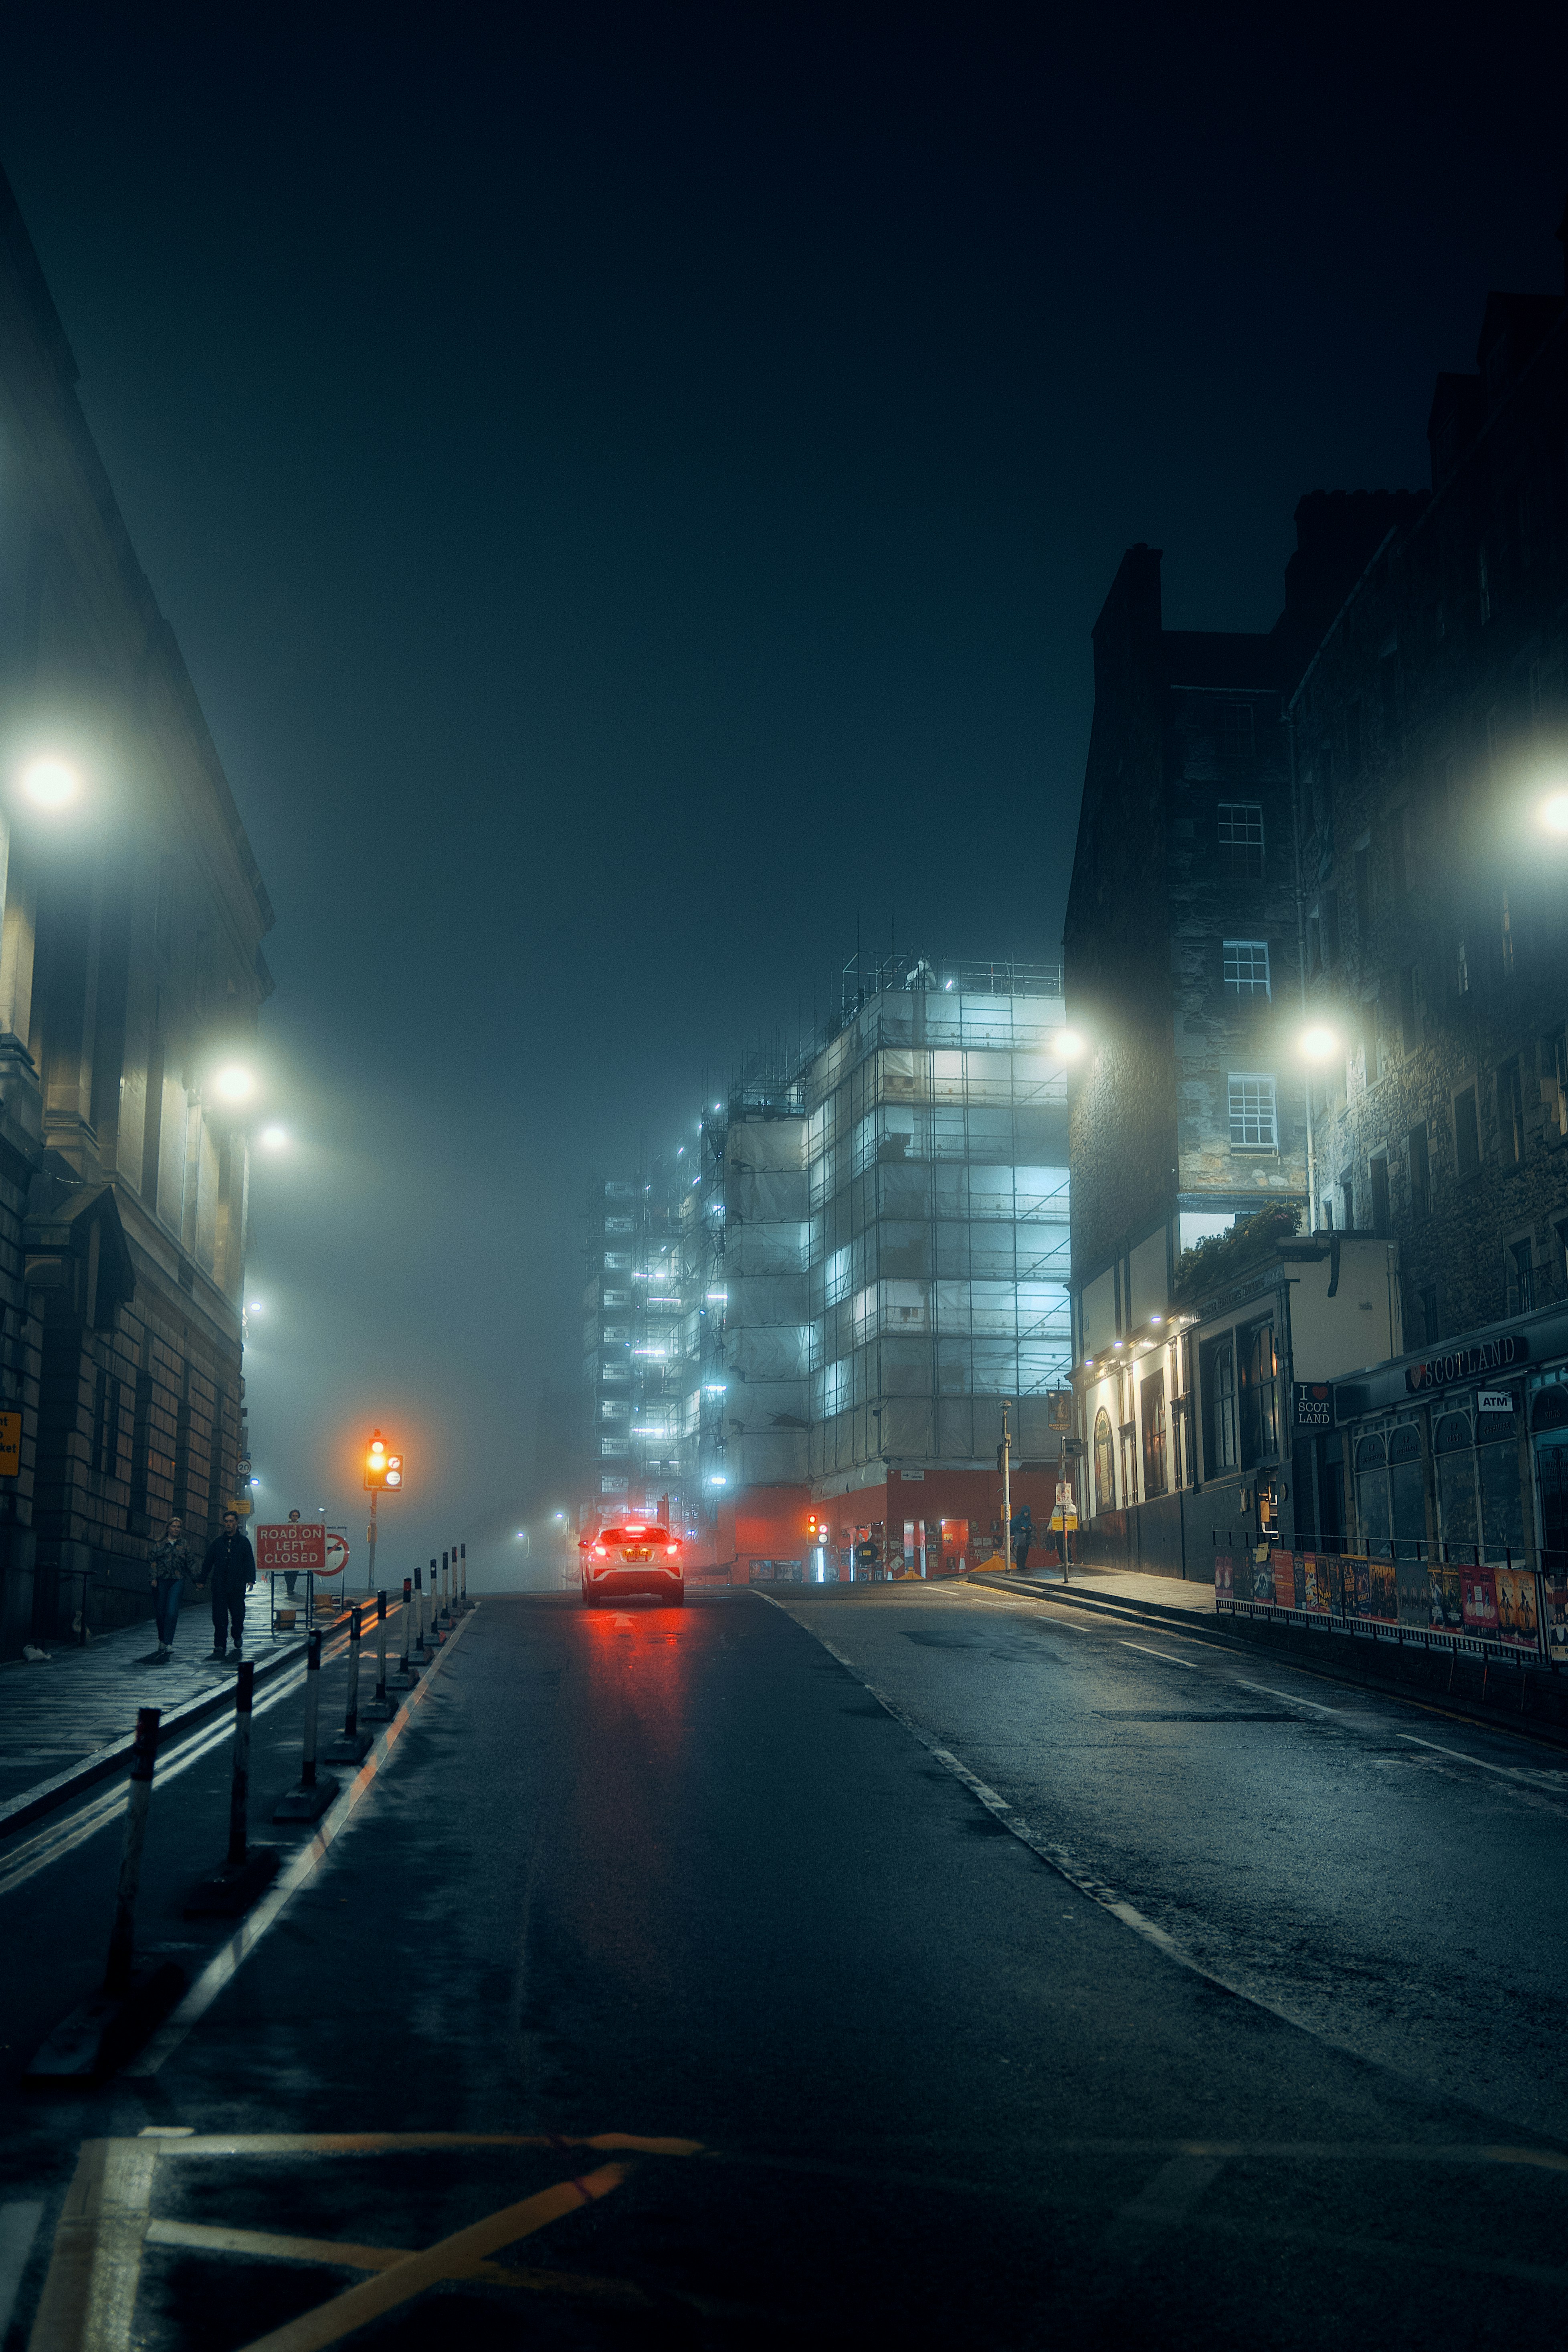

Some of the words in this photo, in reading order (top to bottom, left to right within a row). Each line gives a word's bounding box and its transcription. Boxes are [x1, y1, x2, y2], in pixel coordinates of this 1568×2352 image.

[1425, 1336, 1514, 1387] SCOTLAND
[1300, 1385, 1307, 1400] I
[1483, 1397, 1507, 1406] ATM
[1298, 1402, 1329, 1412] SCOT
[1299, 1413, 1330, 1424] LAND
[1545, 1409, 1560, 1420] KILTS
[1483, 1422, 1510, 1435] CASHMERE
[261, 1529, 297, 1539] ROAD
[302, 1529, 321, 1538] ON
[276, 1541, 305, 1551] LEFT
[264, 1553, 318, 1563] CLOSED
